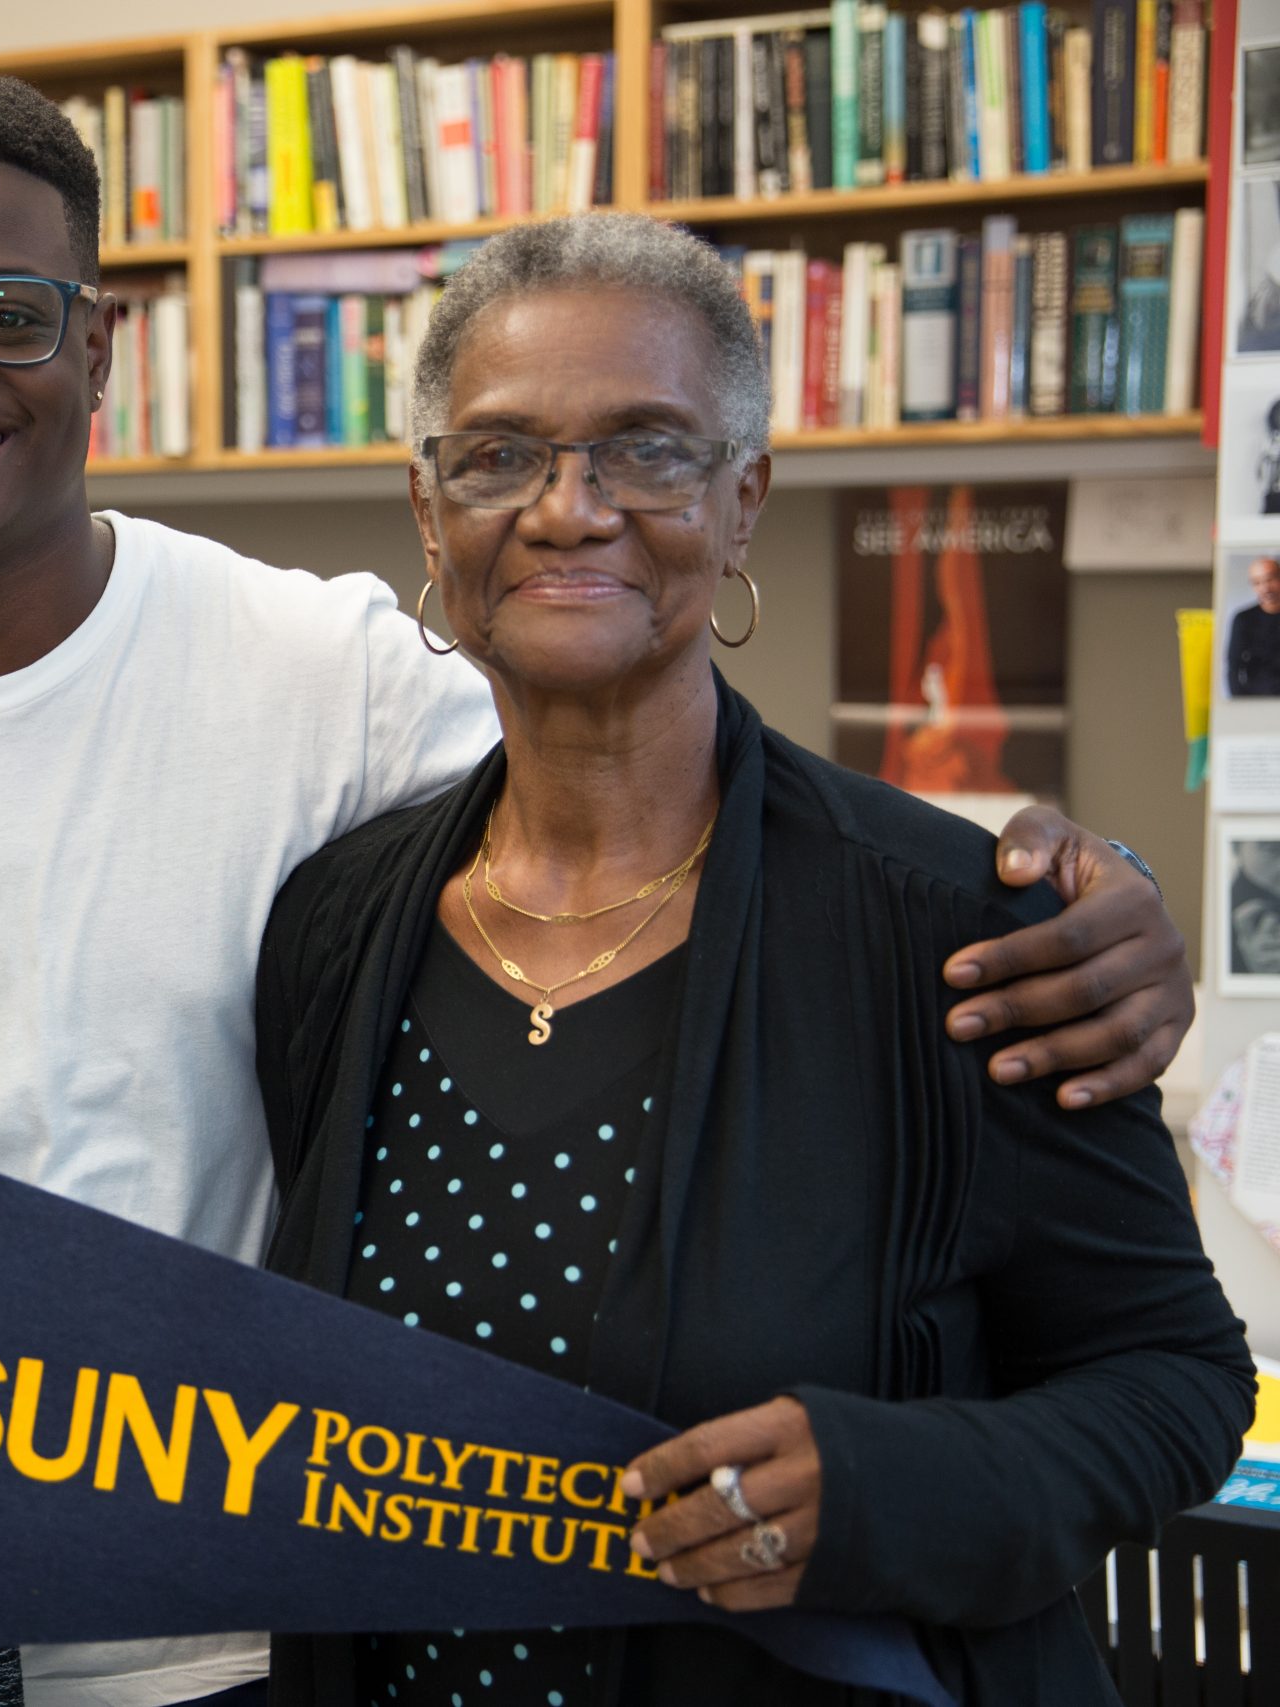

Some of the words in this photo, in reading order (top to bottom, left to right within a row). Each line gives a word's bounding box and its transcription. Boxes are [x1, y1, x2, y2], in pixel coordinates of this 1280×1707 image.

[853, 521, 904, 556] SEE
[910, 519, 1054, 554] AMERICA
[529, 1004, 553, 1044] S
[309, 1410, 679, 1522] POLYTECH
